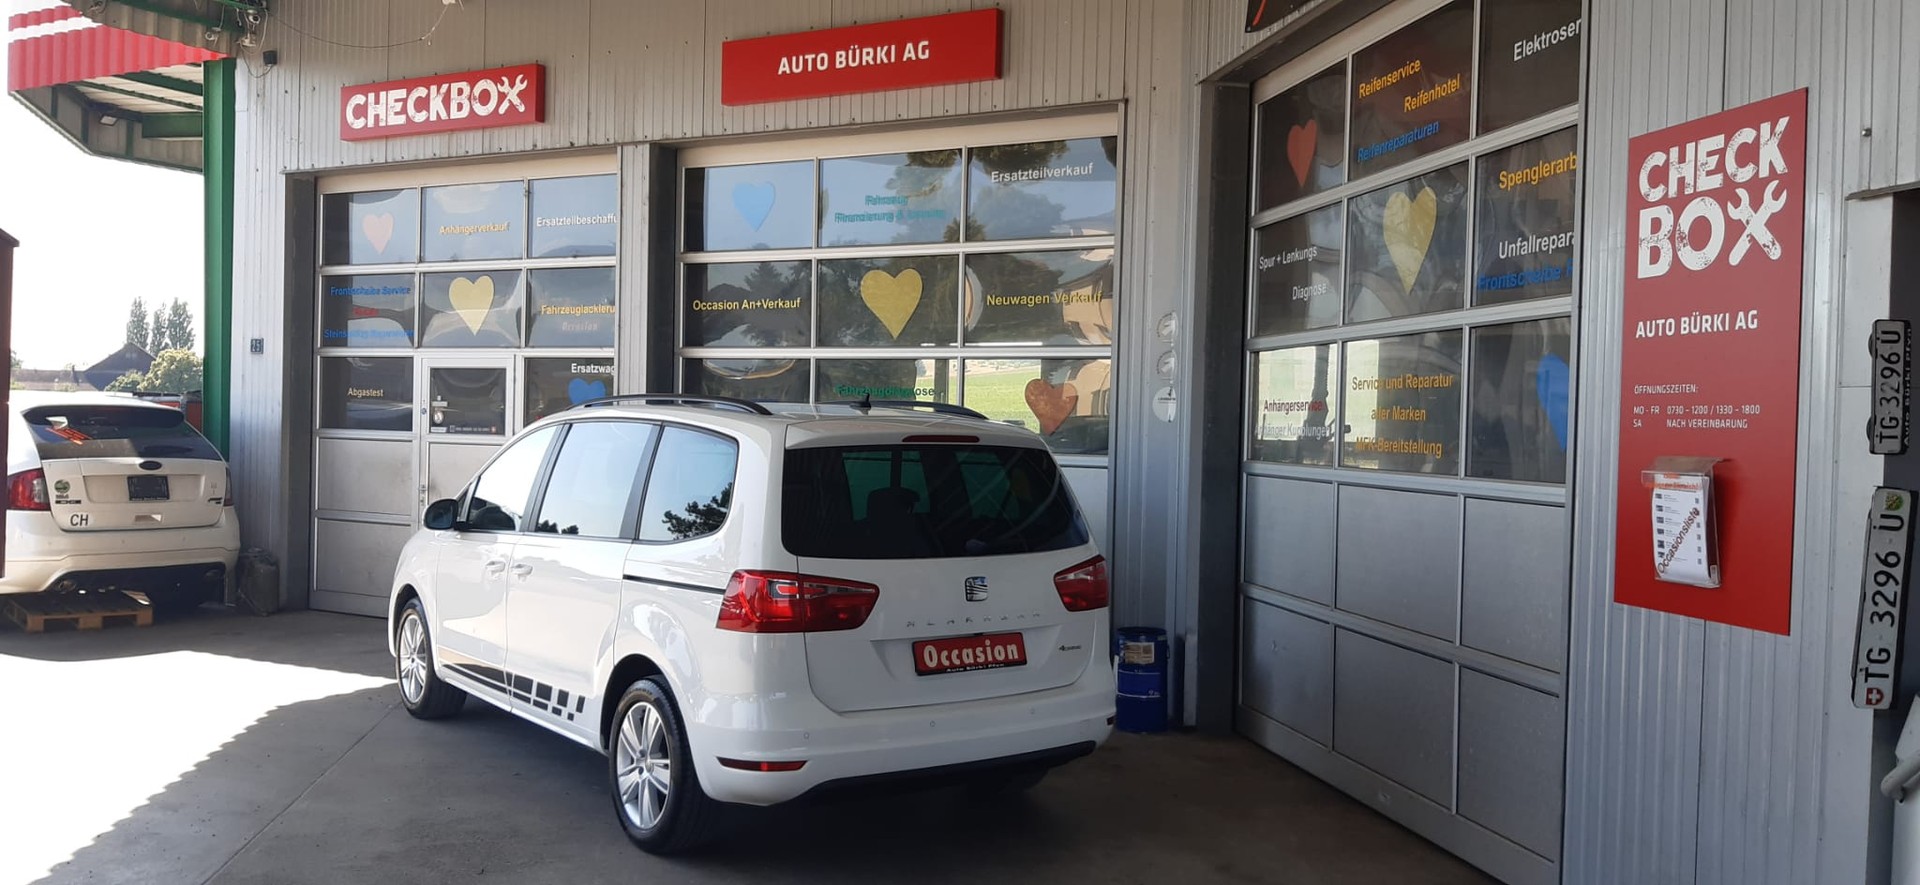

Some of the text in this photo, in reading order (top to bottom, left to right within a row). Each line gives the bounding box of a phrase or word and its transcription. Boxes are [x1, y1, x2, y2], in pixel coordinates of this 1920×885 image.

[777, 40, 930, 75] AUTO BÜRKI AG
[1359, 59, 1421, 98] Reifenservice
[1404, 73, 1460, 112] Reifenhotel
[345, 74, 527, 129] CHECKBOX
[1638, 116, 1790, 202] CHECK
[991, 163, 1094, 184] Ersatzteilverkauf
[1637, 179, 1787, 279] BOX
[1259, 256, 1275, 271] Spur
[1282, 246, 1317, 264] Lenkungs
[692, 297, 801, 312] Occasion An+Verkauf
[986, 291, 1102, 307] Neuwagen Verkauf
[1292, 283, 1327, 301] Diagnose
[1635, 310, 1758, 338] AUTO BÜRKI AG
[347, 387, 384, 398] Abgastest
[1352, 373, 1454, 392] Service und Reparatur
[1880, 352, 1901, 407] 3296
[1392, 405, 1426, 420] Marken
[1633, 406, 1644, 415] MO
[1650, 406, 1660, 414] FR
[1667, 405, 1684, 414] 0730
[1691, 405, 1708, 414] 1200
[1716, 405, 1733, 414] 1330
[1741, 405, 1760, 414] 1800
[1633, 418, 1748, 428] SA NACH VEREINBARUNG
[1880, 416, 1899, 444] TG
[70, 514, 89, 527] CH
[1870, 550, 1901, 628] 3296
[923, 639, 1019, 668] Occasion
[1864, 647, 1891, 684] TG
